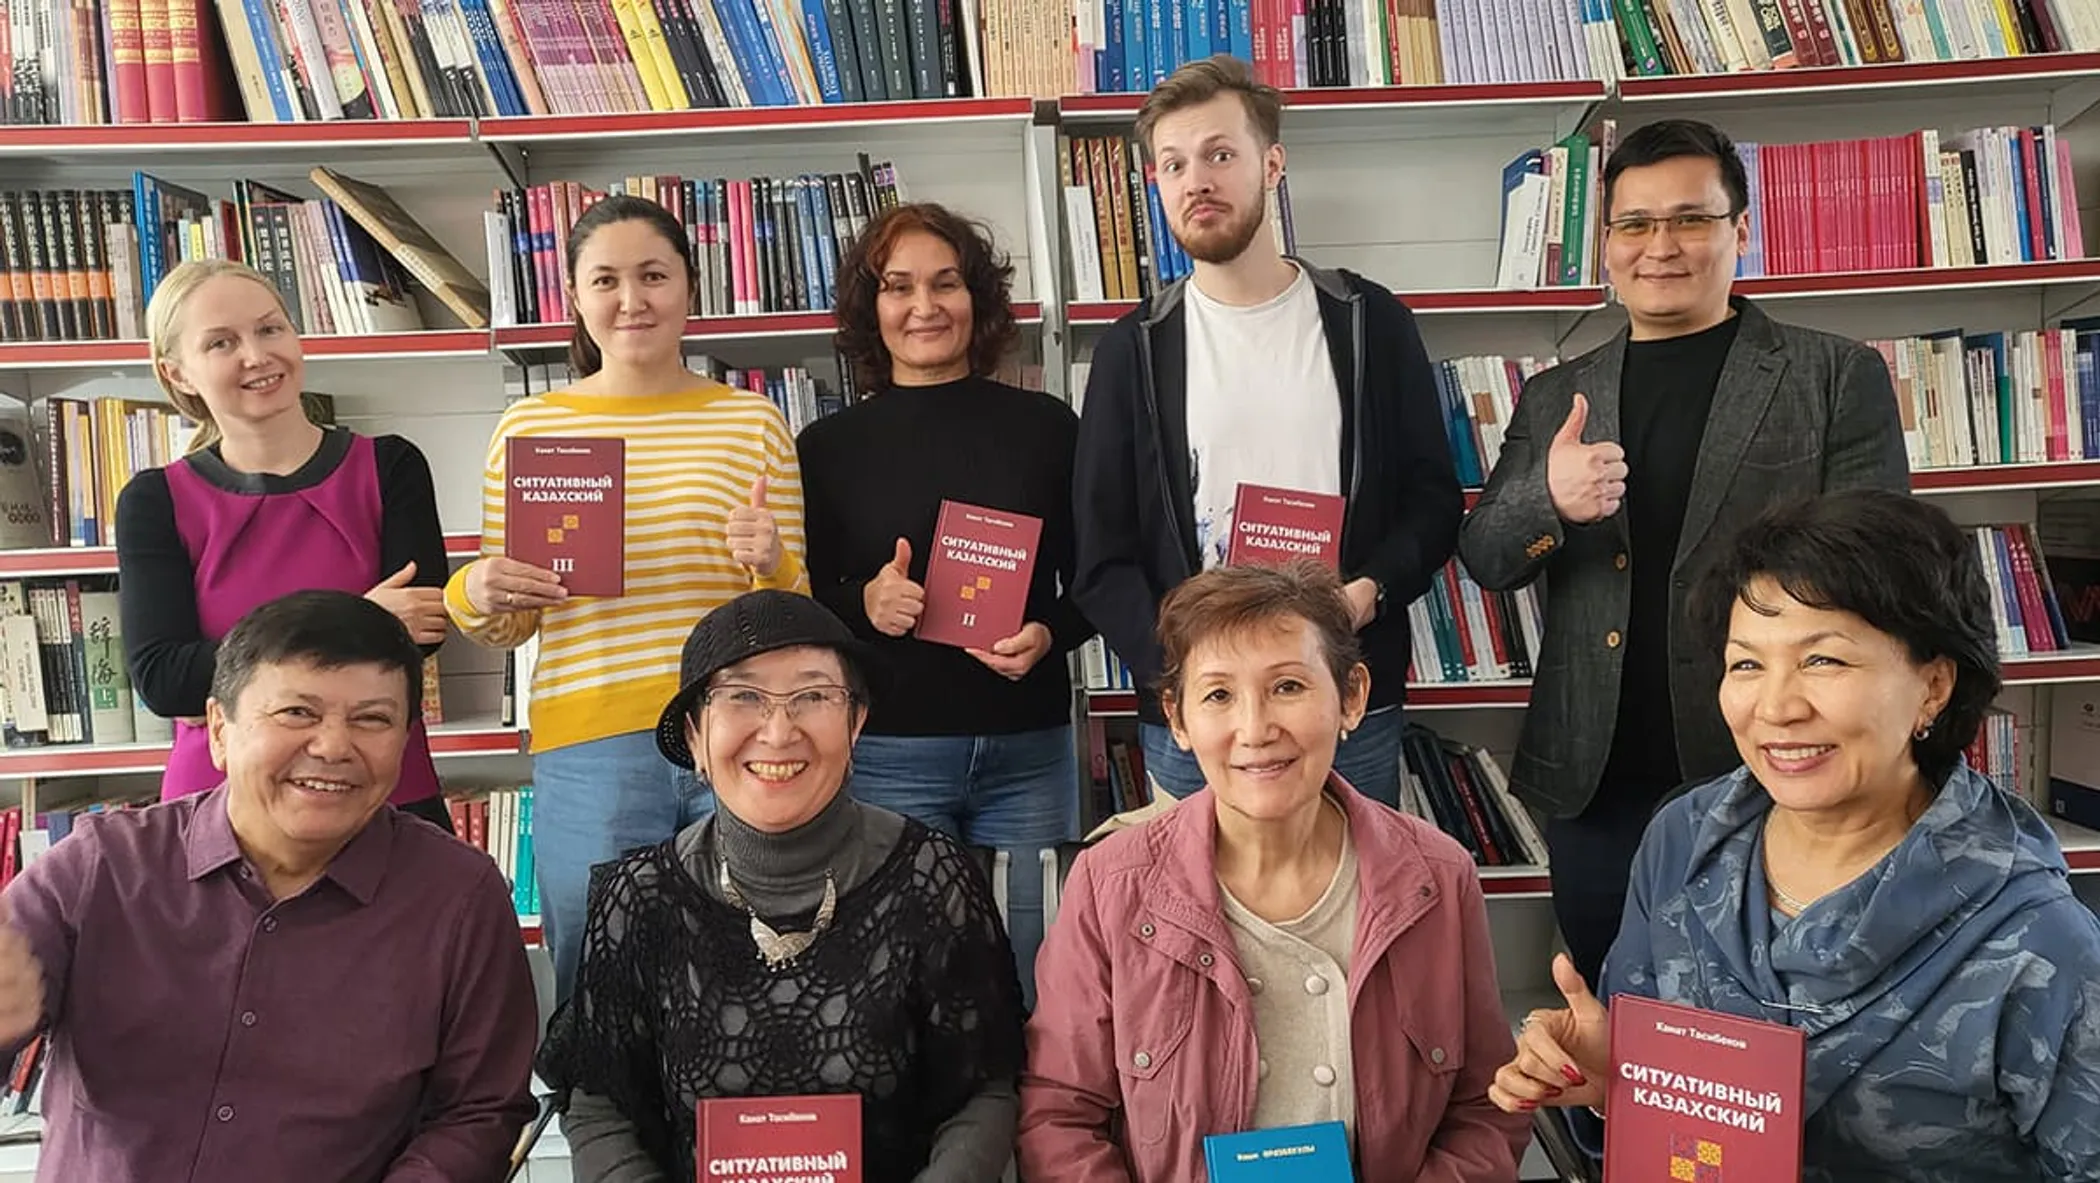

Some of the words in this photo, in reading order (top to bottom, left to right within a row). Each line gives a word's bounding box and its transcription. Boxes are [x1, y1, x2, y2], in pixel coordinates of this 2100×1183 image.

[513, 475, 613, 488] СИТУАТИВНЫЙ
[523, 490, 604, 502] КАЗАХСКИЙ
[1239, 521, 1331, 543] СИТУАТИВНЫЙ
[941, 535, 1027, 561] СИТУАТИВНЫЙ
[1245, 536, 1321, 555] КАЗАХСКИЙ
[553, 558, 574, 572] III
[946, 550, 1017, 572] КАЗАХСКИЙ
[962, 613, 977, 627] II
[1620, 1062, 1782, 1114] СИТУАТИВНЫЙ
[1633, 1087, 1766, 1134] КАЗАХСКИЙ
[709, 1151, 847, 1175] СИТУАТИВНЫЙ
